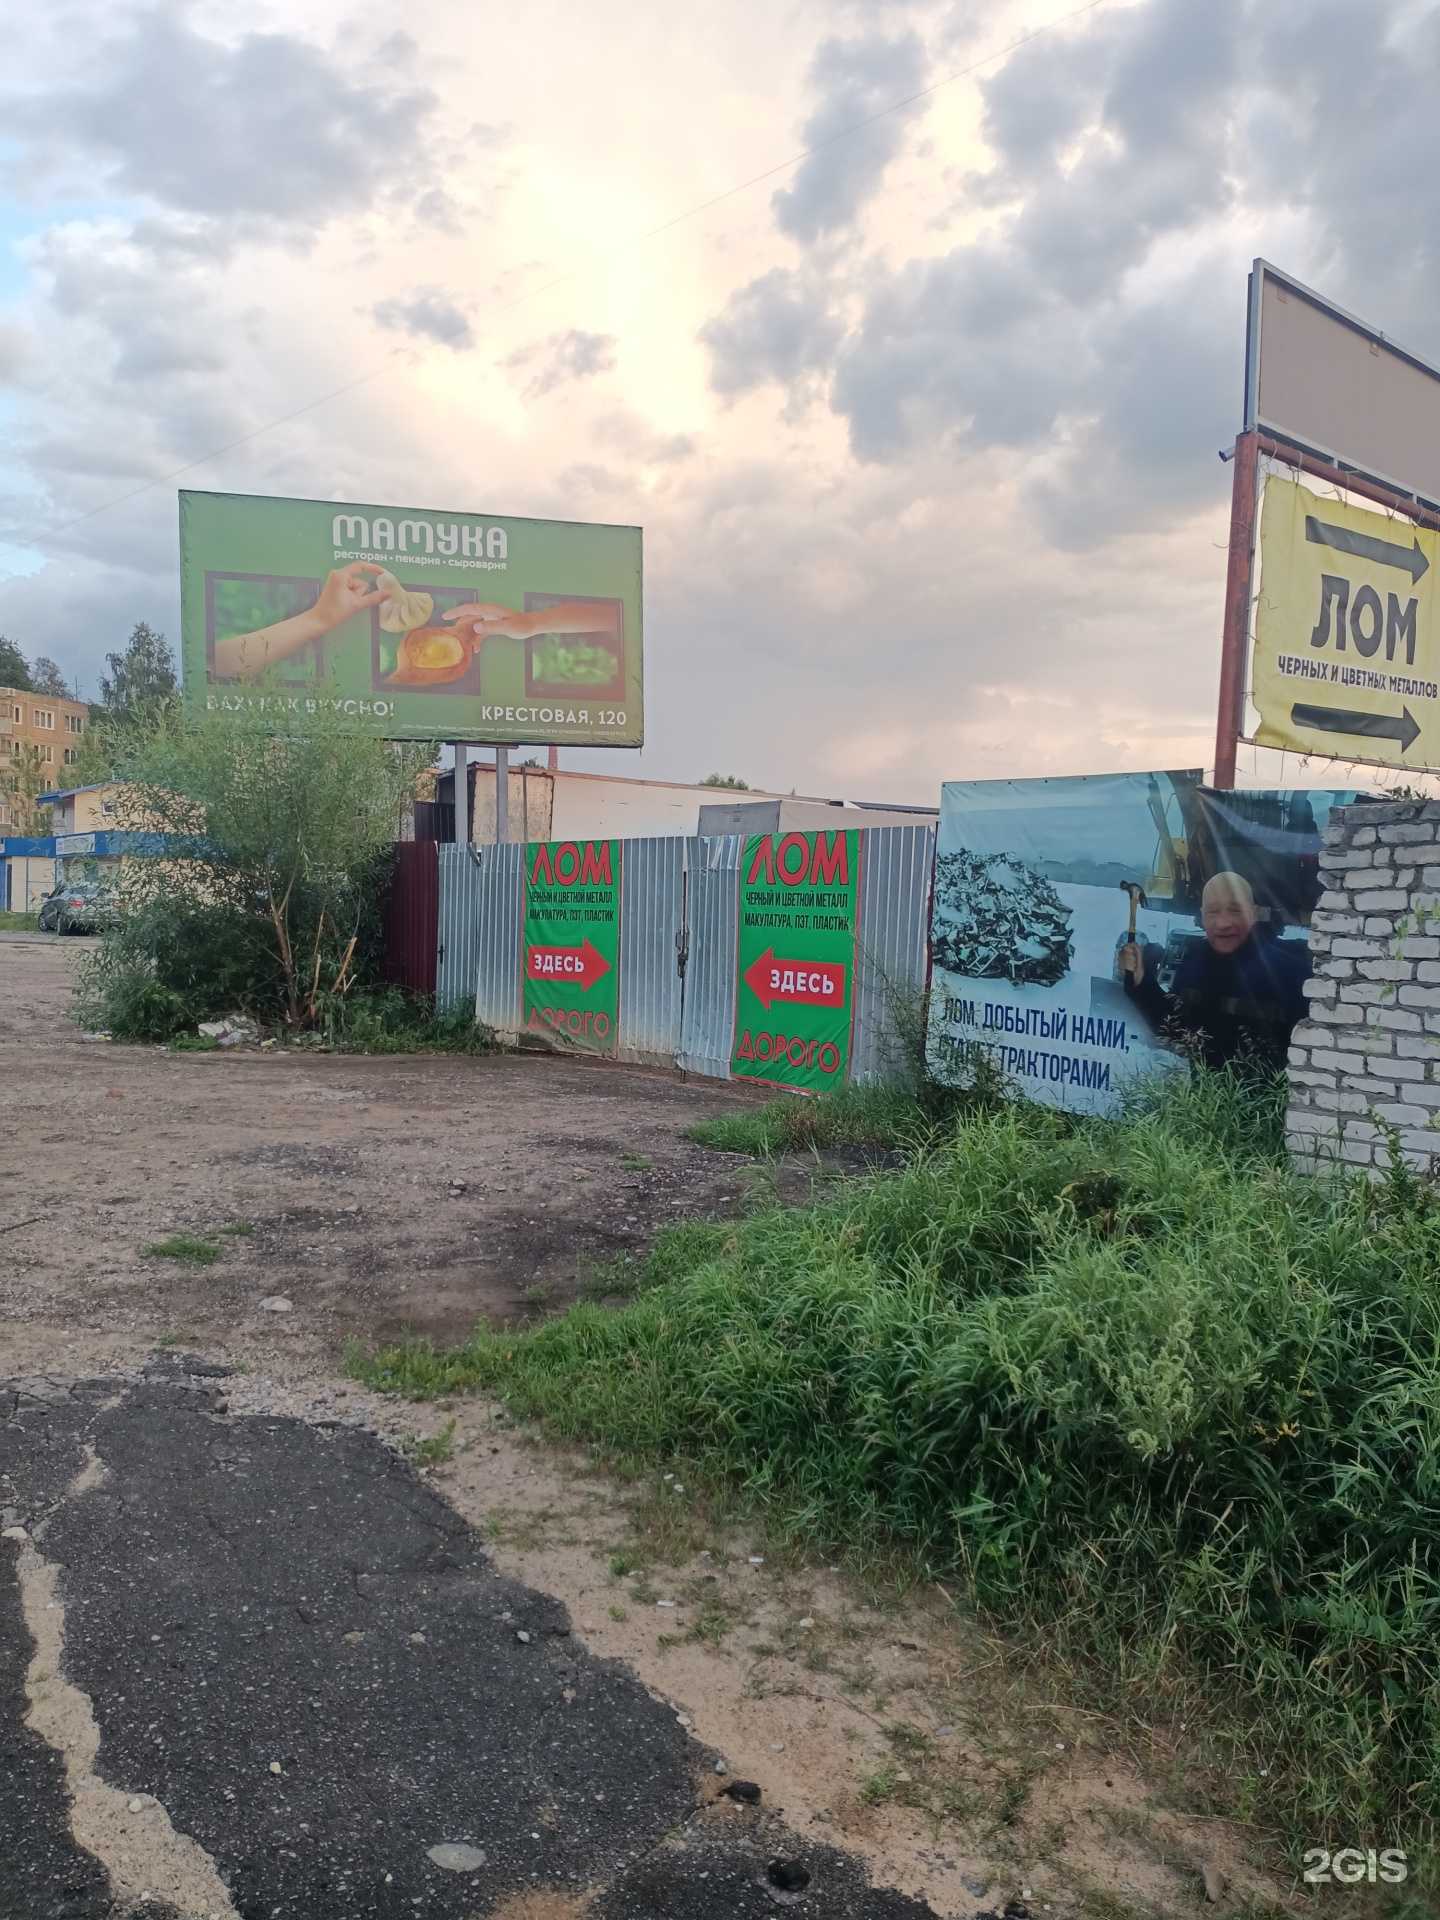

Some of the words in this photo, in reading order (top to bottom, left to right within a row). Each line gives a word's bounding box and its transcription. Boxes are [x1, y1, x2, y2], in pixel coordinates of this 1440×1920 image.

[332, 514, 508, 559] МАМУКА
[334, 550, 387, 562] ресторан
[395, 556, 441, 566] пекарня
[448, 559, 508, 571] сыроварня
[1311, 574, 1419, 665] ЛОМ
[1278, 655, 1328, 680] ЧЕРНЫХ
[1331, 665, 1340, 681] И
[1341, 666, 1386, 690] ЦВЕТНЫХ
[1389, 677, 1438, 698] МЕТАЛЛОВ
[482, 705, 594, 725] КРЕСТОВАЯ,
[599, 711, 627, 726] 120
[529, 841, 614, 886] ЛОМ
[745, 832, 850, 887] ЛОМ
[558, 889, 584, 905] ЦВЕТНОЙ
[586, 891, 613, 904] МЕТАЛЛ
[745, 890, 773, 906] ЧЕРНЫЙ
[782, 890, 814, 908] ЦВЕТНОЙ
[816, 893, 848, 908] МЕТАЛЛ
[584, 910, 614, 922] ПЛАСТИК
[812, 916, 849, 932] ПЛАСТИК
[533, 953, 585, 974] ЗДЕСЬ
[769, 969, 834, 994] ЗДЕСЬ
[527, 1004, 610, 1039] ДОРОГО
[982, 1003, 1067, 1040] ДОБЫТЫЙ
[736, 1029, 840, 1073] ДОРОГО
